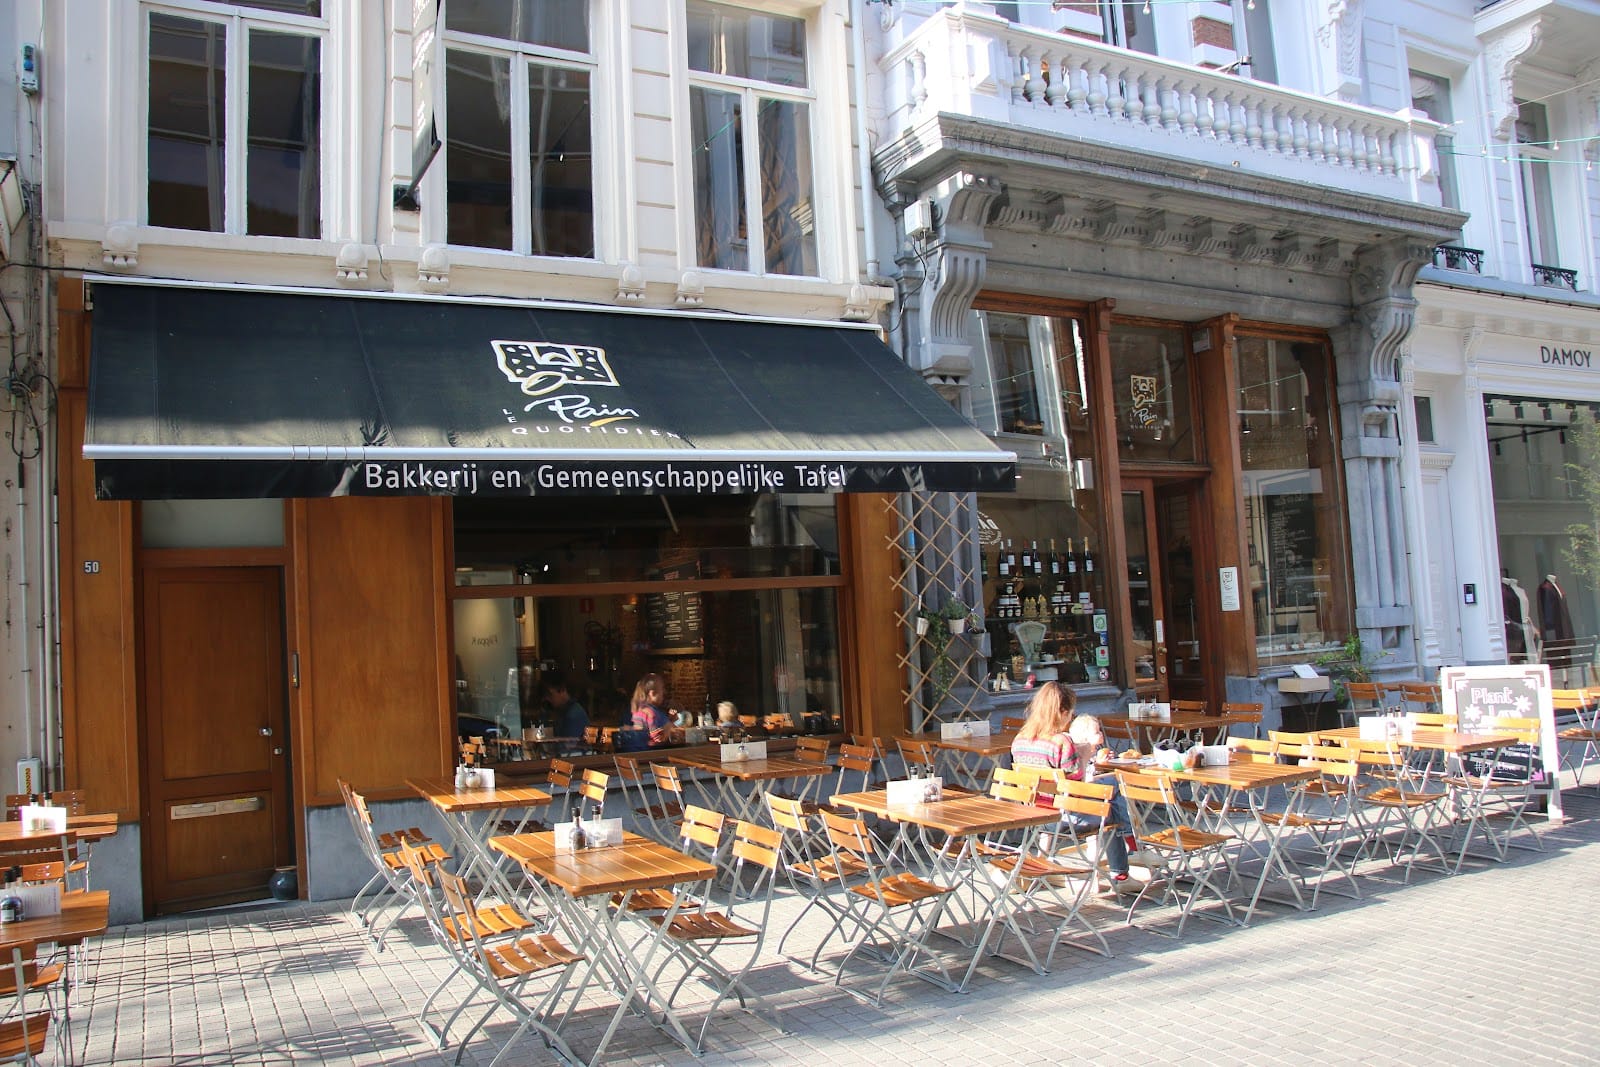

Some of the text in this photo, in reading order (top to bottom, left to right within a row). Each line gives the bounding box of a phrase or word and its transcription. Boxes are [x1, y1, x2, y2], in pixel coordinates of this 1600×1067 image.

[1540, 346, 1592, 368] DAMOY
[524, 394, 640, 423] Pain
[511, 425, 681, 440] QUOTIDIEN
[364, 463, 847, 493] Bakkerij en Gemeenschappelijke Tafel
[84, 561, 99, 573] 50
[1471, 687, 1514, 705] Plant
